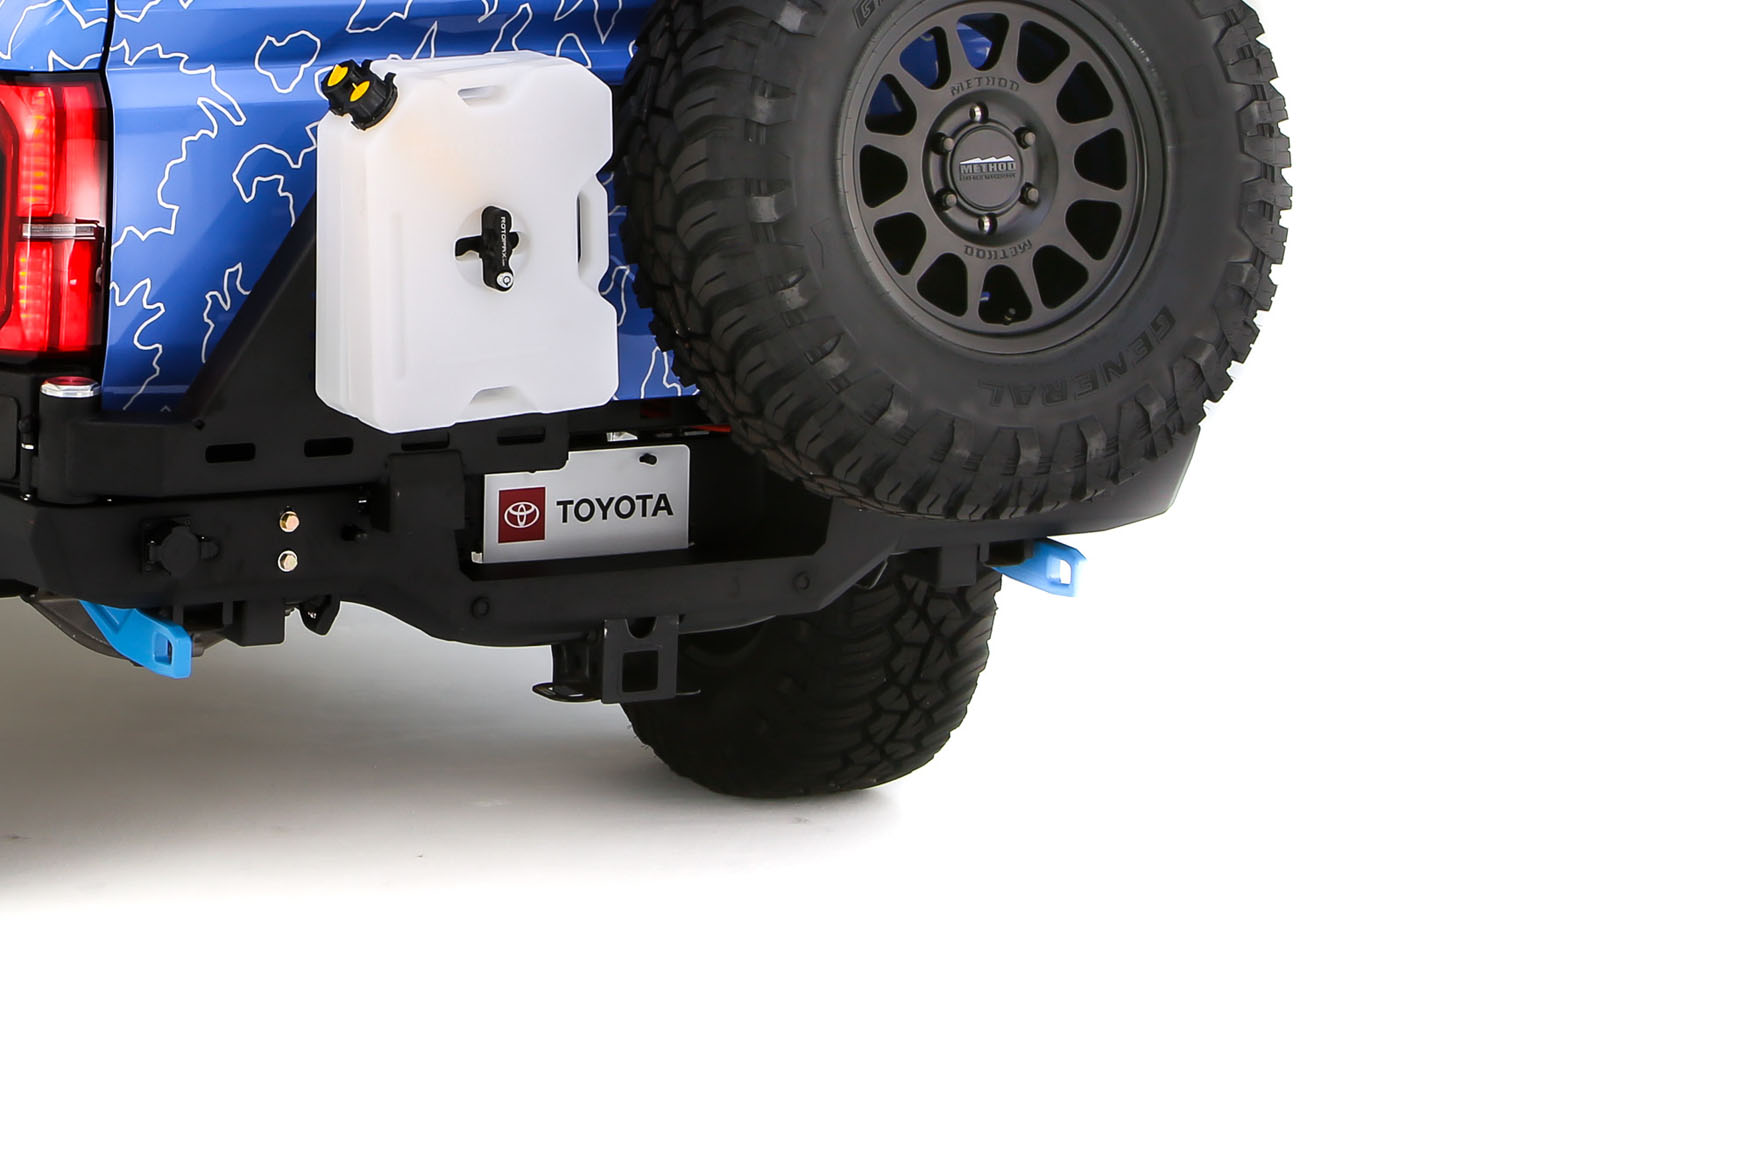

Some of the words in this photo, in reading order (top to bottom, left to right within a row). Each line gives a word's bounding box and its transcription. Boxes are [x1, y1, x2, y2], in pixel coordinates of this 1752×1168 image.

[950, 75, 1021, 97] METHOD
[959, 160, 1017, 175] METHOD
[977, 304, 1177, 409] GENERAL
[555, 493, 674, 524] TOYOTA
